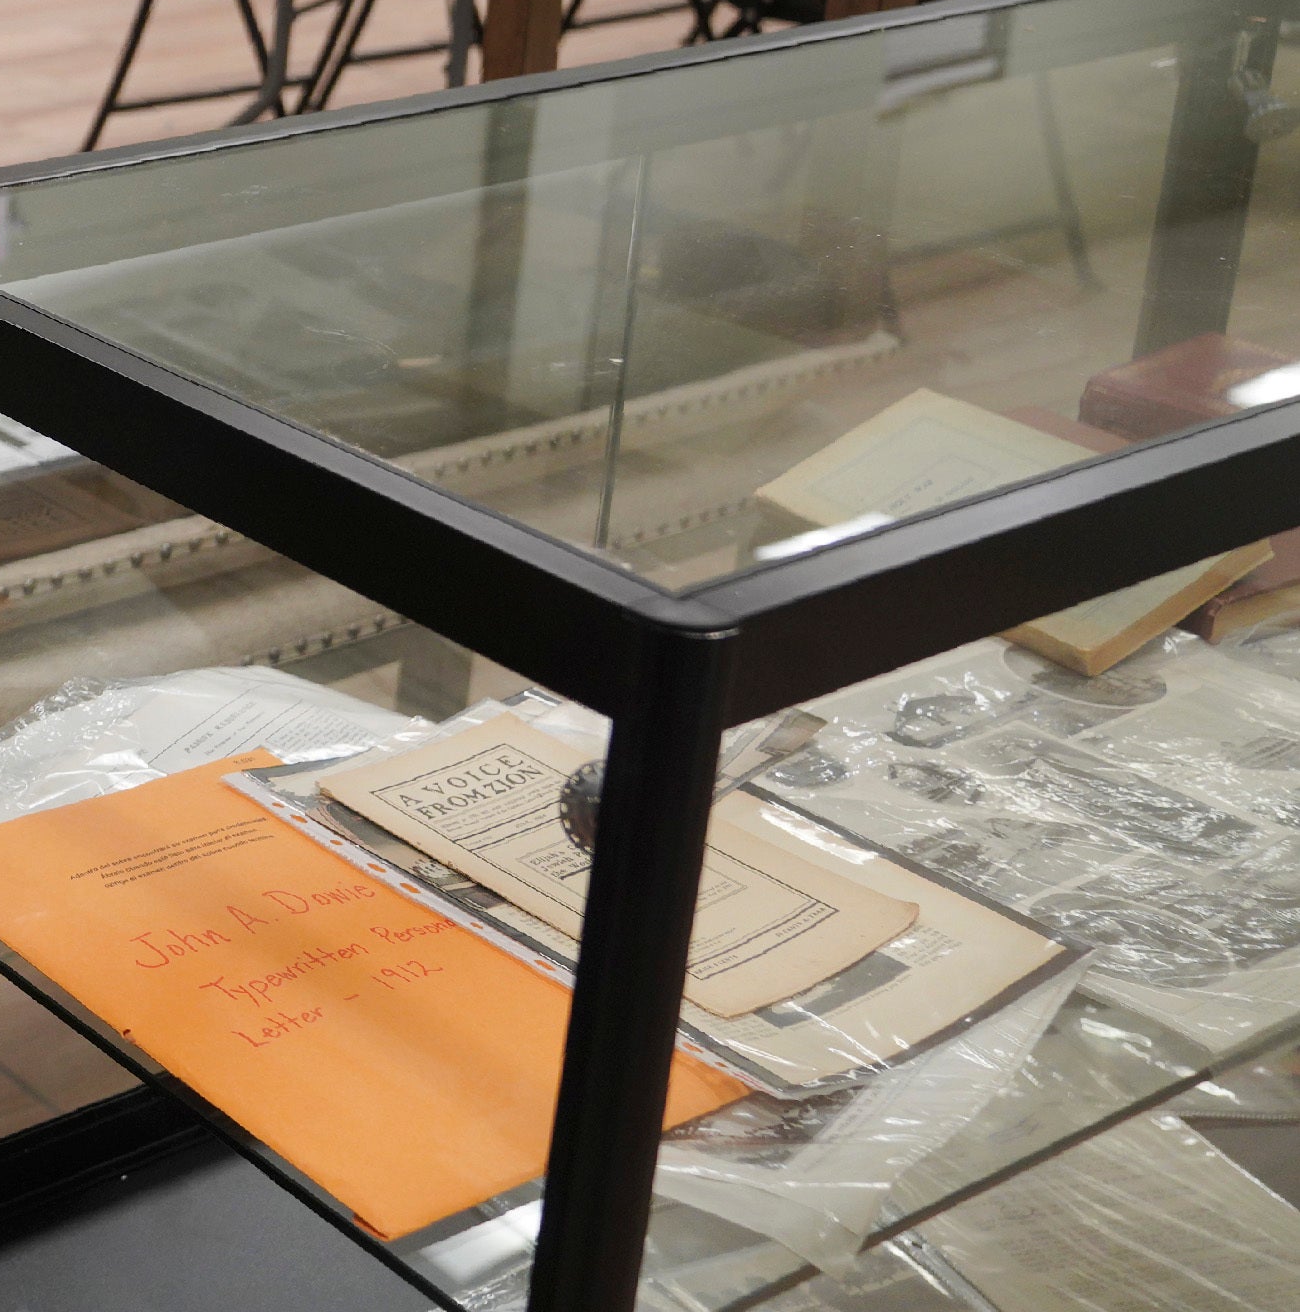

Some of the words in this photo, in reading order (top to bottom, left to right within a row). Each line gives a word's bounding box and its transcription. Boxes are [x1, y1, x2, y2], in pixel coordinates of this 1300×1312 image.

[399, 794, 422, 807] A
[423, 755, 523, 794] VOICE
[416, 789, 486, 819] FROM
[484, 765, 543, 794] ZION
[131, 929, 230, 968] John
[227, 906, 277, 934] A.
[264, 885, 375, 915] Dowie
[199, 944, 367, 1007] Typewritten
[371, 918, 456, 944] Persona
[232, 1007, 322, 1047] Letter
[374, 960, 442, 989] 1912
